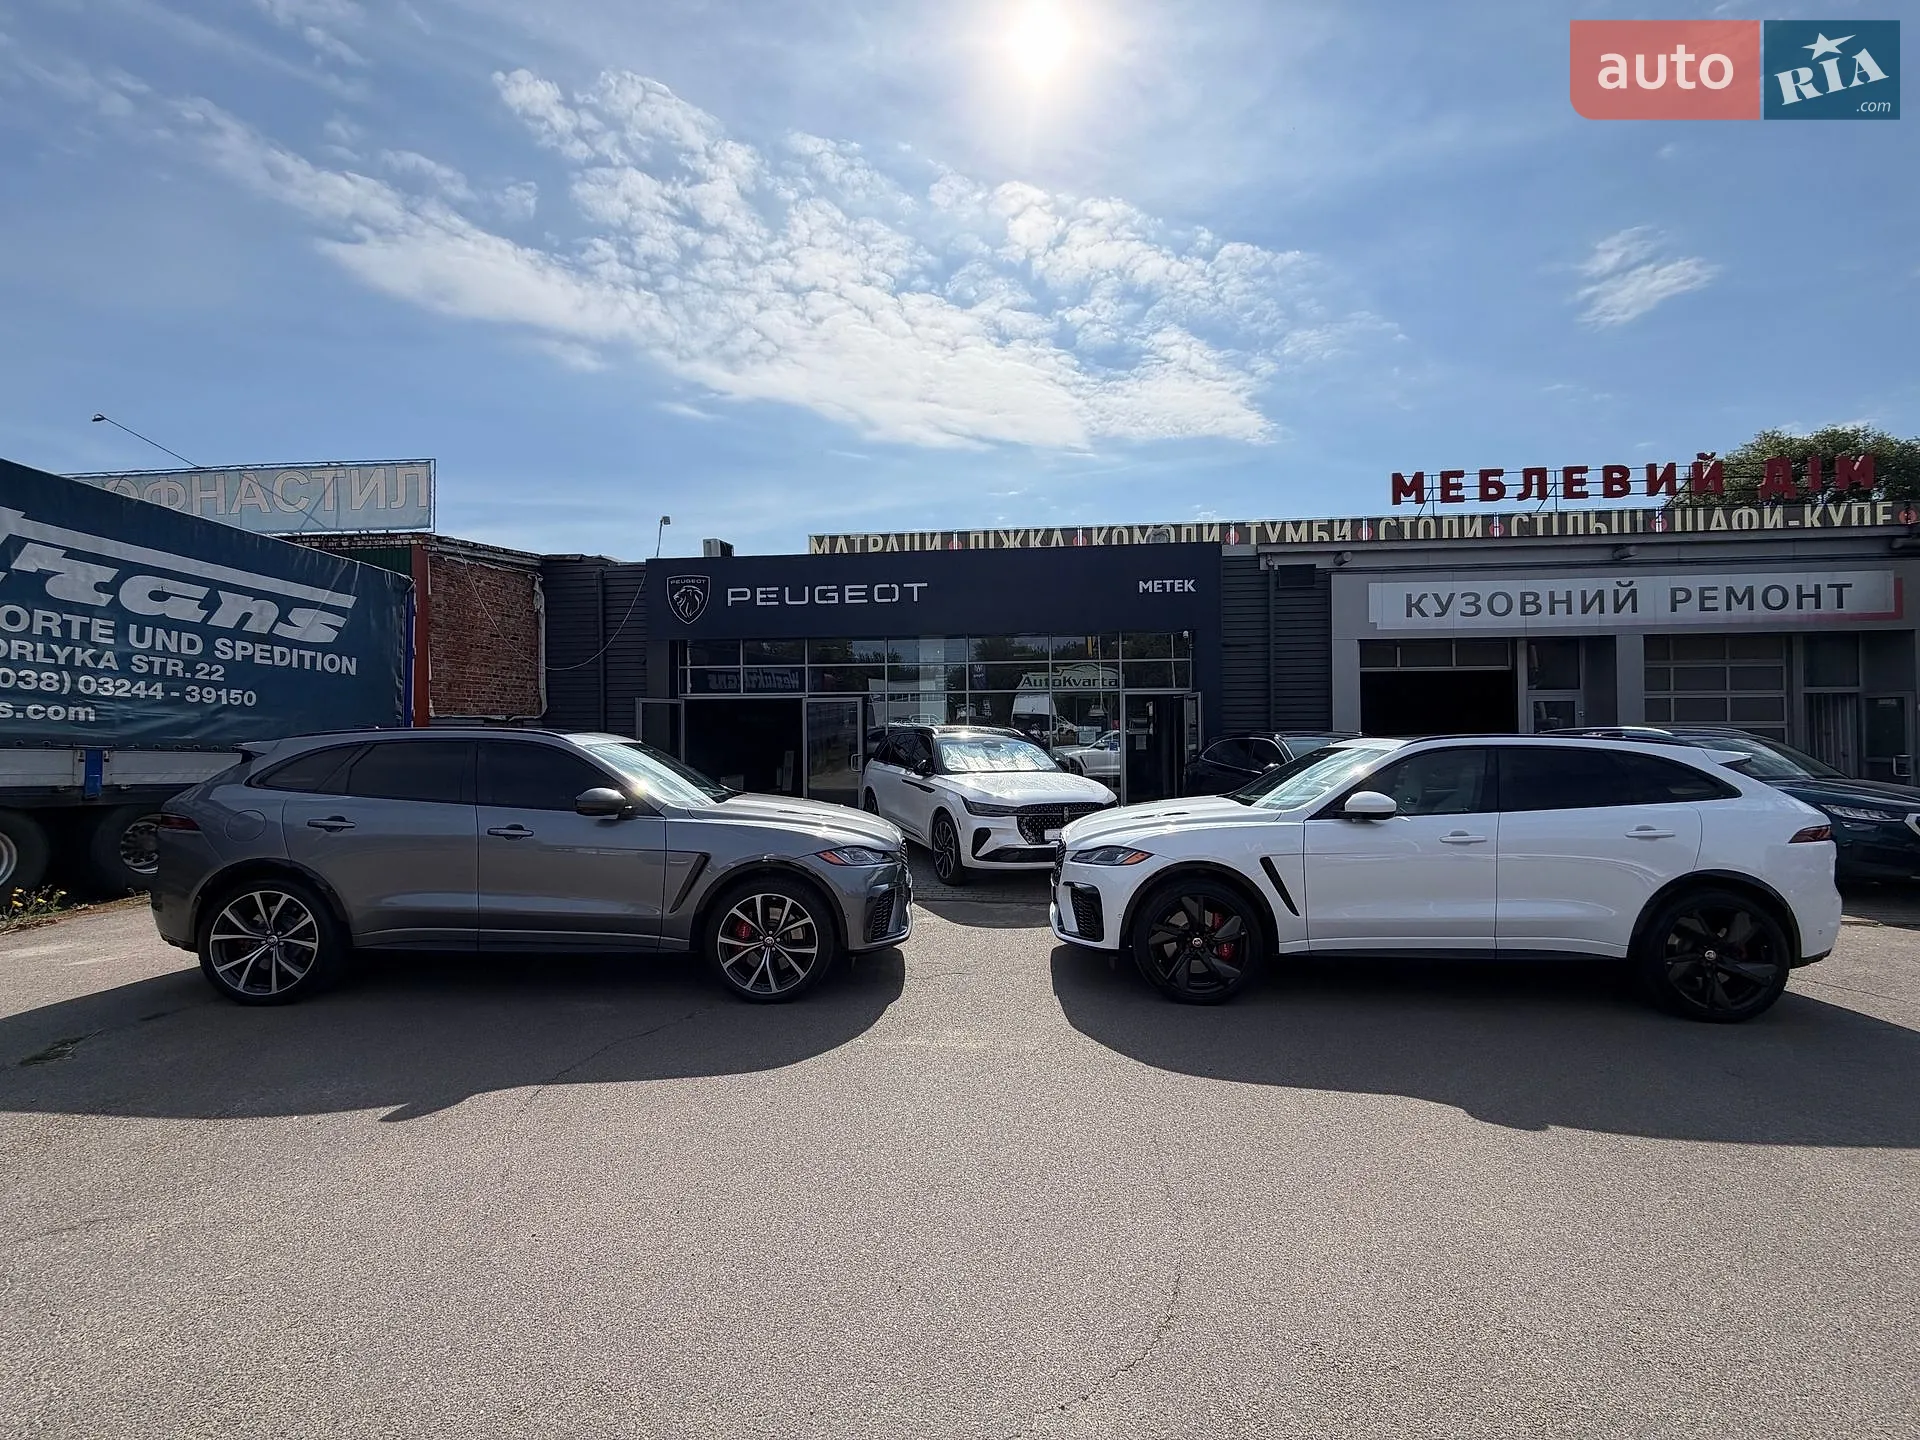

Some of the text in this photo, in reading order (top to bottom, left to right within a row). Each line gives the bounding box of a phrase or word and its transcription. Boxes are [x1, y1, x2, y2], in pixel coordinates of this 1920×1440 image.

[1391, 452, 1876, 505] МЕБЛЕВИЙ ДІМ
[727, 582, 929, 607] PEUGEOT
[1404, 581, 1853, 619] КУЗОВНИЙ РЕМОНТ
[128, 623, 204, 655] UND
[214, 637, 357, 676] SPEDITION
[78, 675, 165, 700] 03244
[185, 685, 257, 707] 39150
